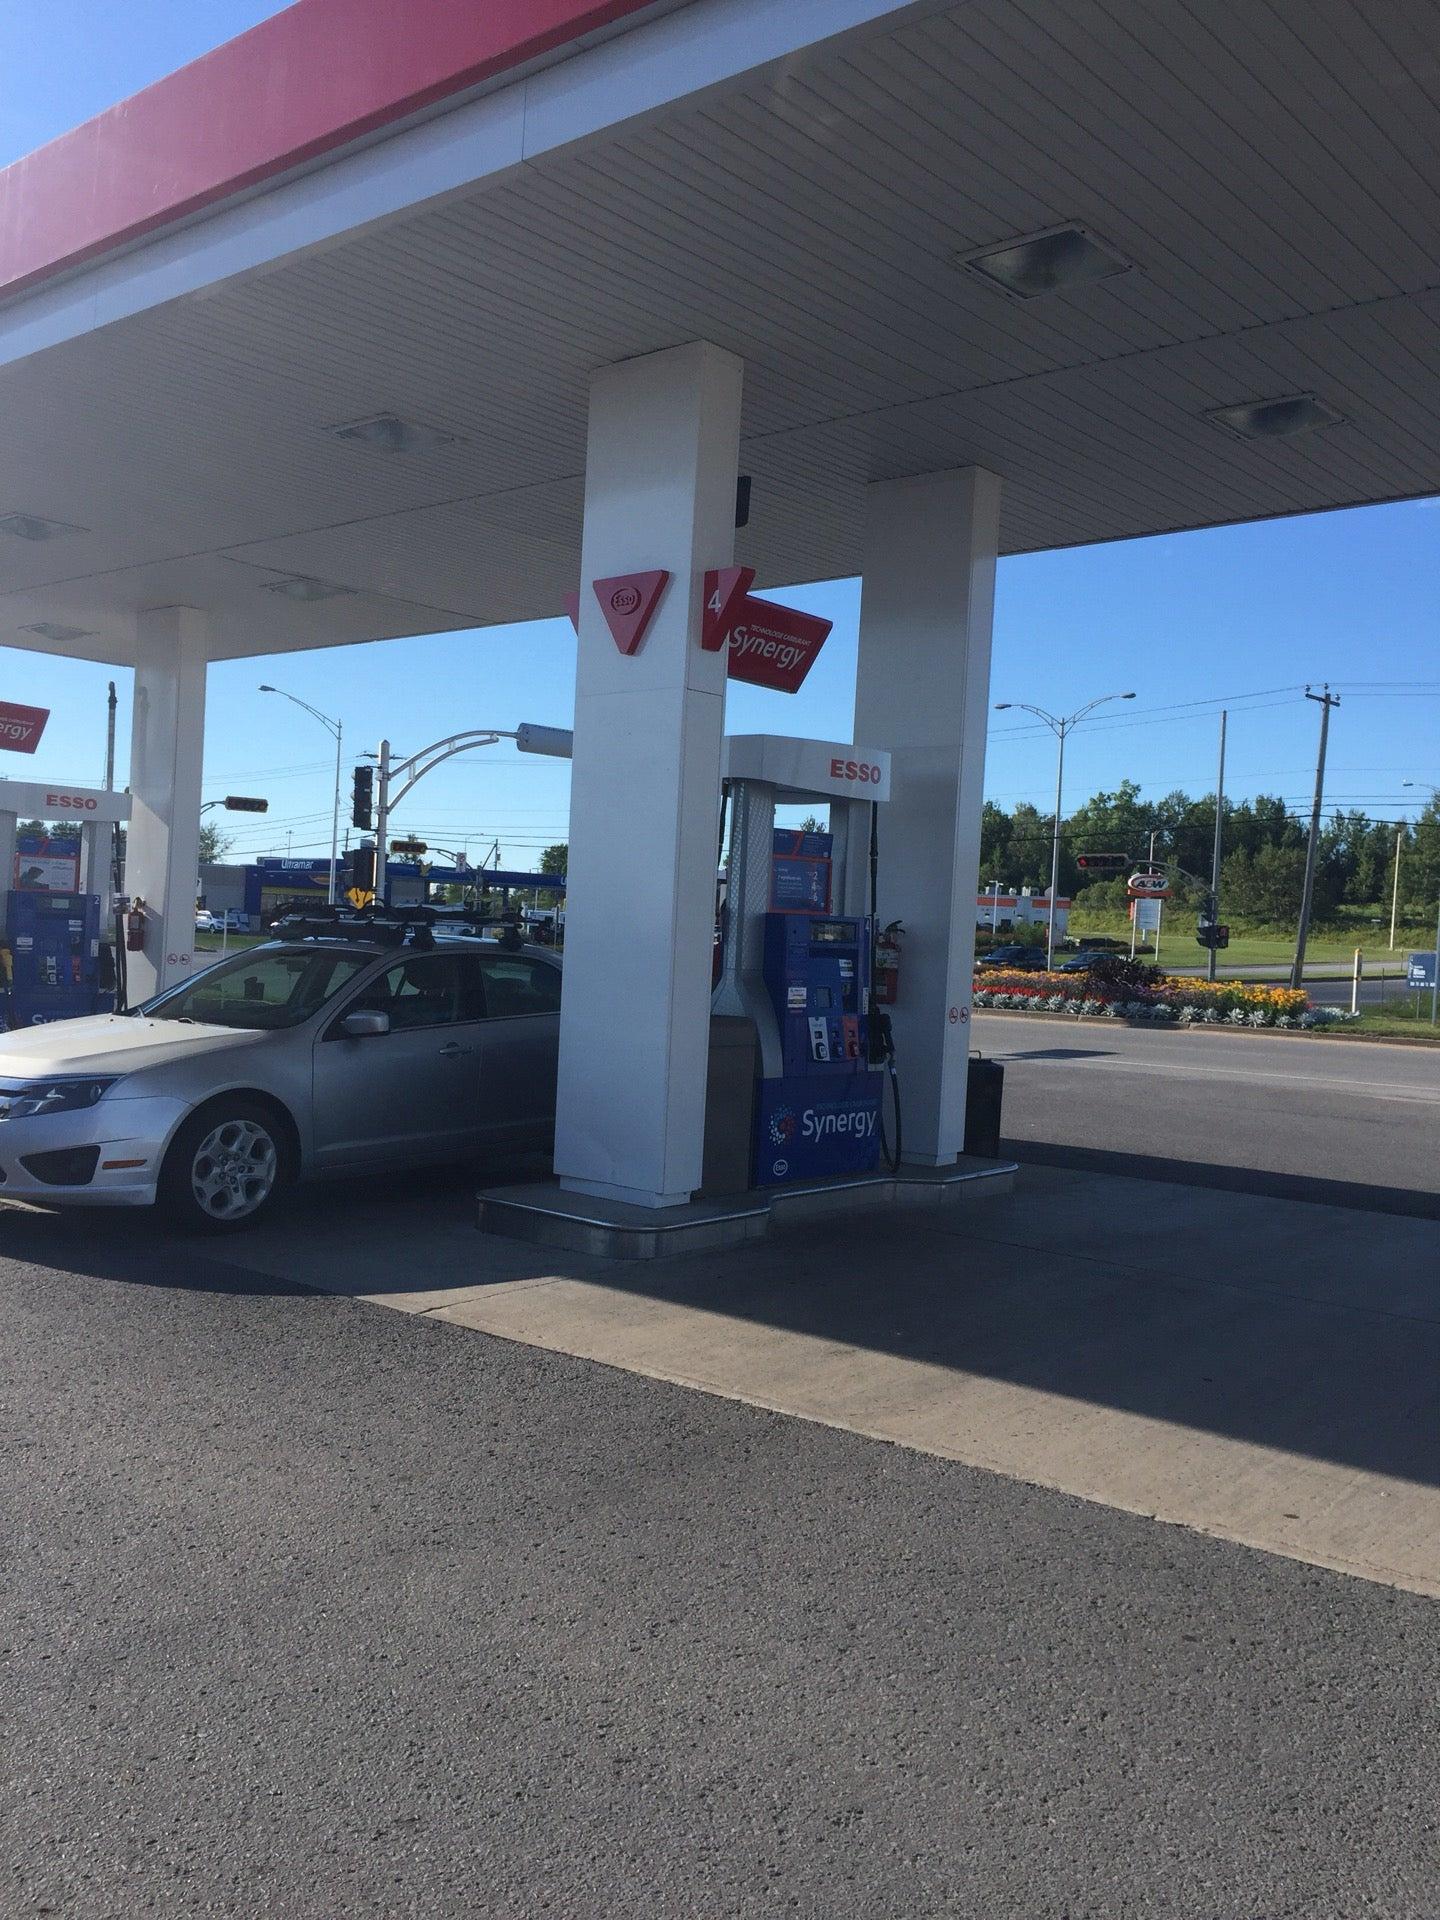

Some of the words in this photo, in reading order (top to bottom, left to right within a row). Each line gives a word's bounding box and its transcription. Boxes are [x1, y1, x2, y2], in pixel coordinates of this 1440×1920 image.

[707, 590, 721, 614] 4
[729, 625, 806, 670] Synergy
[830, 758, 882, 785] ESSO
[46, 794, 98, 810] ESSO
[281, 859, 314, 869] Ultramar
[1136, 879, 1166, 889] A&W
[94, 895, 100, 905] 2
[801, 1109, 877, 1143] Synergy
